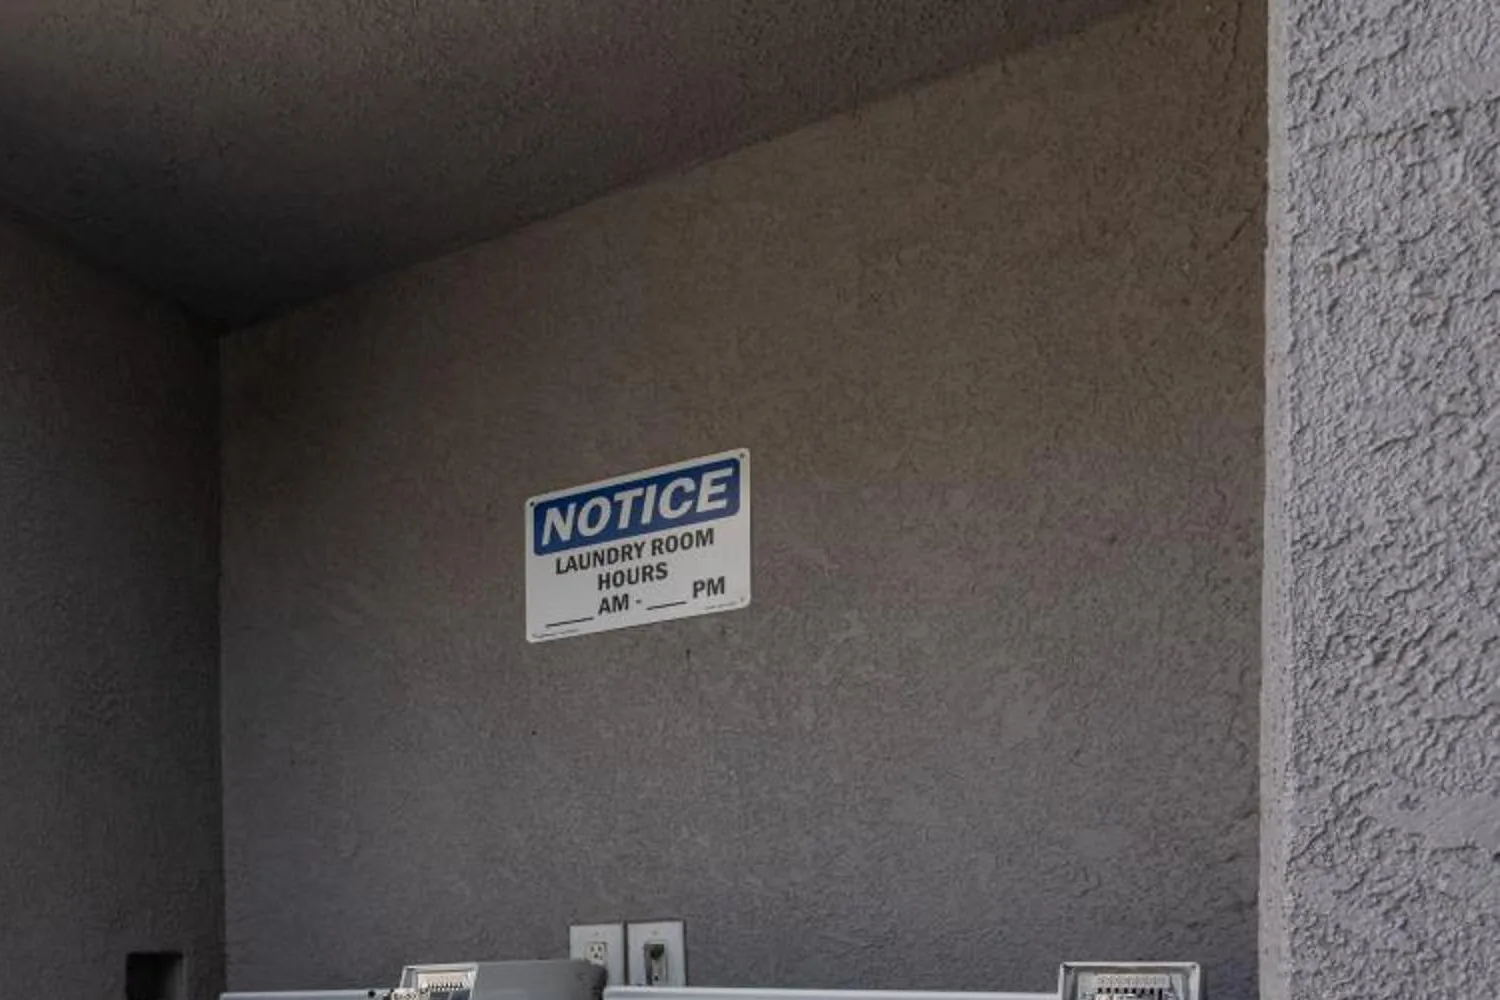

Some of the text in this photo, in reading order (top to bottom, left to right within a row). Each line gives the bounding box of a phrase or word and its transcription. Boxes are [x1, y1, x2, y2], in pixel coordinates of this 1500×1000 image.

[541, 467, 734, 547] NOTICE
[555, 527, 715, 575] LAUNDRY ROOM
[597, 561, 669, 591] HOURS
[597, 593, 629, 615] AM
[692, 576, 726, 599] PM
